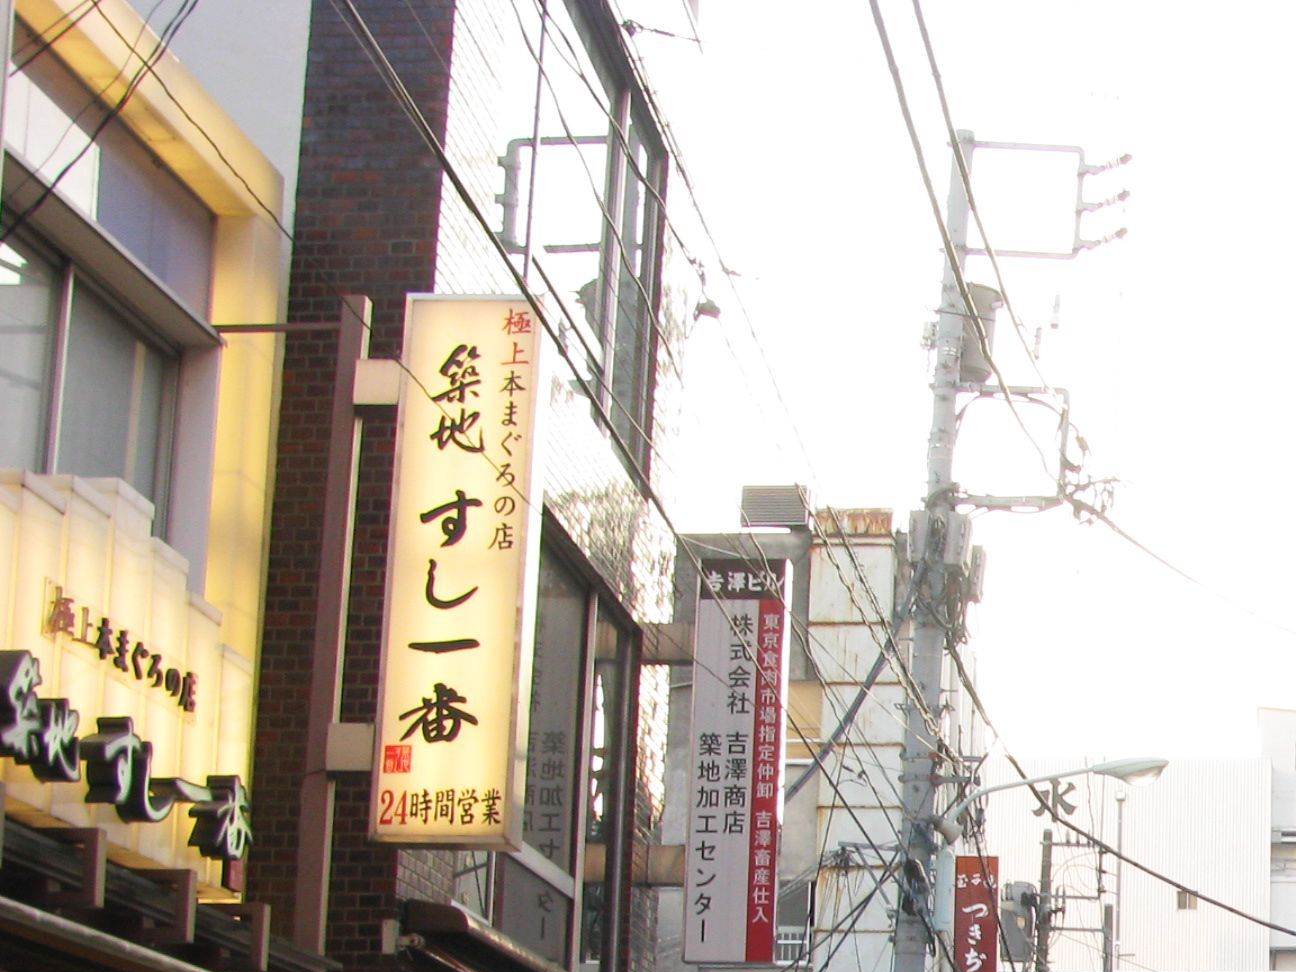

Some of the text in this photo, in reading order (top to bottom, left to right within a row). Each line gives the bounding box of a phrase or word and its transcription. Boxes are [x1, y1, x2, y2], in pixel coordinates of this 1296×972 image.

[487, 308, 532, 551] 極上本まぐろの店
[50, 585, 199, 713] 極上本まぐろの店
[705, 570, 785, 593] 吉澤ビル
[379, 787, 502, 825] 24時間営業
[722, 612, 754, 835] 株式会社 吉澤商店
[752, 613, 780, 923] 東京食肉市場指定仲卸 吉澤畜産仕入
[694, 733, 722, 943] 築地加工センター
